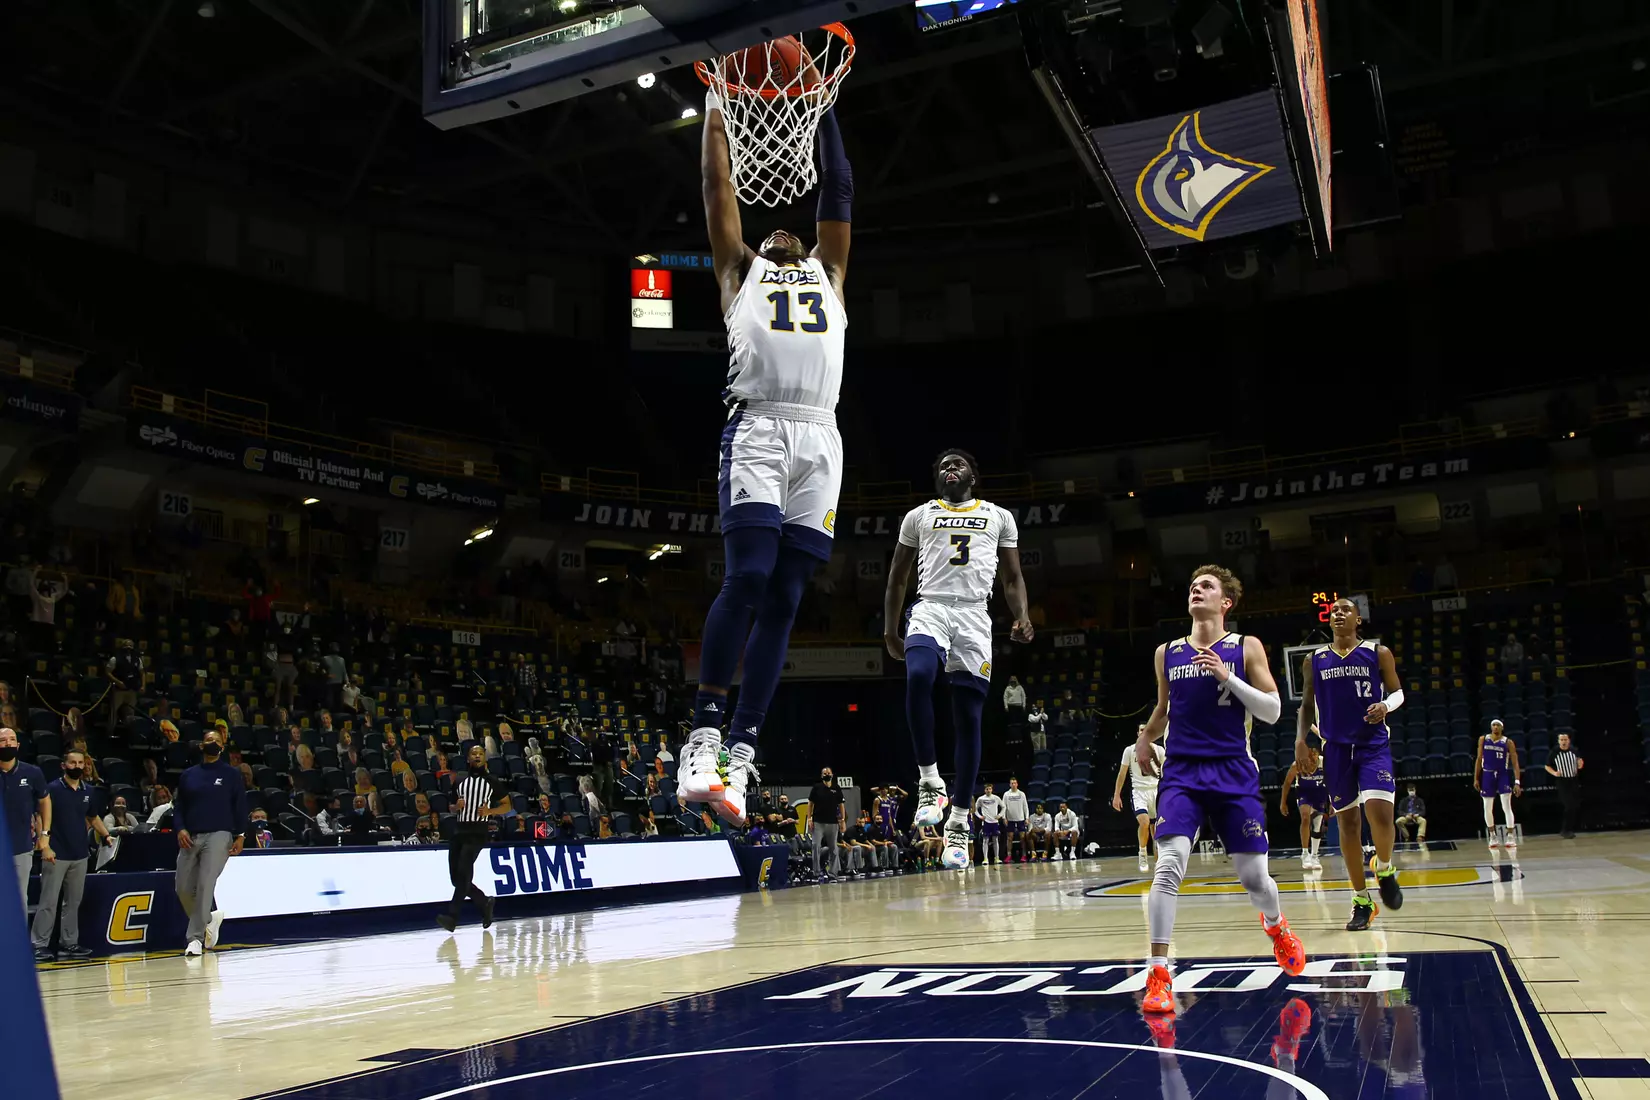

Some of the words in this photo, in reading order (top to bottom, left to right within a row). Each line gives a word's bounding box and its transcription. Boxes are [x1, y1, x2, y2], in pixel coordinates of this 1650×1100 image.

[922, 15, 973, 32] DAKTRONICS
[661, 255, 698, 267] HOME
[704, 256, 714, 267] O
[761, 269, 819, 285] MOCS
[766, 290, 828, 333] 13
[7, 394, 67, 419] erlanger
[140, 424, 178, 447] epb
[182, 440, 204, 453] Fiber
[206, 445, 236, 461] Optics
[273, 450, 313, 468] Official
[317, 458, 360, 477] Internet
[364, 468, 384, 483] And
[298, 468, 315, 482] TV
[319, 471, 361, 491] Partner
[164, 494, 188, 514] 216
[451, 493, 472, 504] Fiber
[473, 496, 497, 507] Optics
[574, 503, 652, 528] JOIN
[1444, 502, 1471, 520] 222
[934, 517, 988, 530] MOCS
[383, 530, 405, 548] 217
[1225, 530, 1248, 546] 221
[949, 534, 971, 566] 3
[1312, 592, 1338, 604] 29.1
[1439, 600, 1459, 610] 121
[1318, 603, 1334, 623] 2
[458, 633, 475, 644] 116
[1168, 664, 1200, 682] WESTERN
[1320, 667, 1345, 680] WESTERN
[1345, 665, 1370, 677] CAROLINA
[1217, 682, 1232, 706] 2
[1354, 680, 1373, 698] 12
[839, 778, 851, 787] 117
[489, 844, 594, 896] SOME
[106, 890, 155, 946] C
